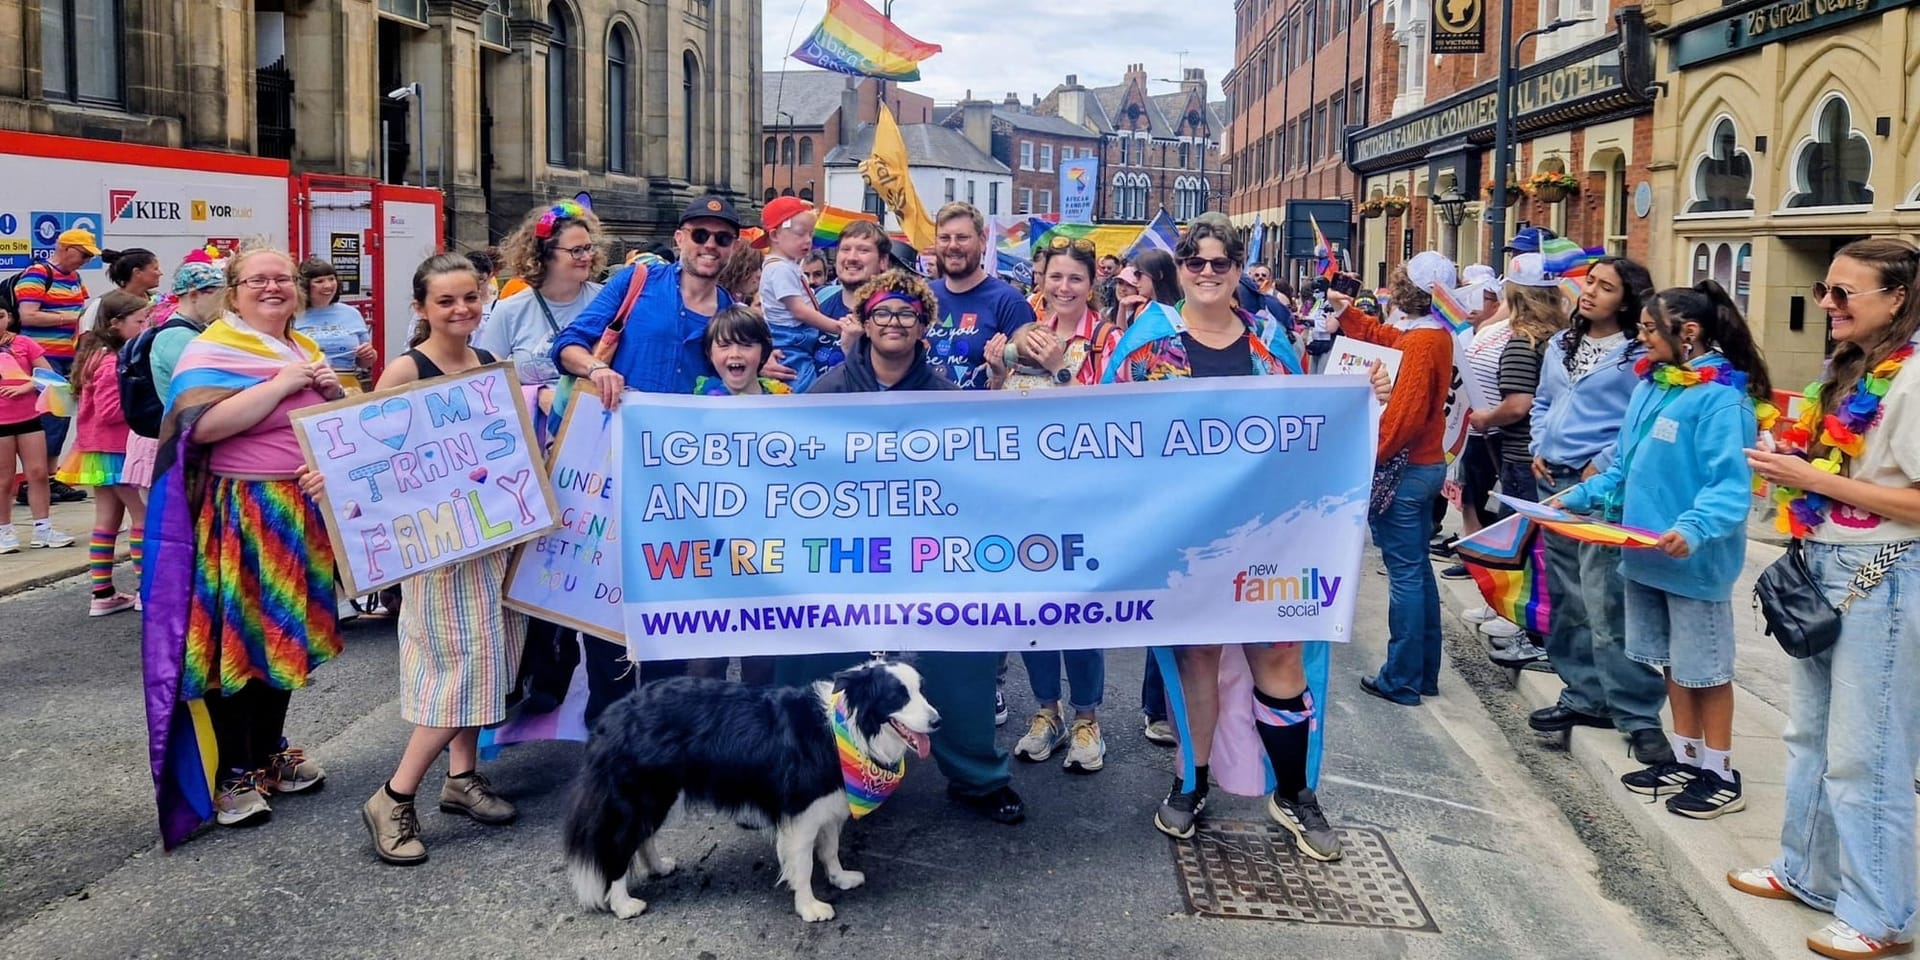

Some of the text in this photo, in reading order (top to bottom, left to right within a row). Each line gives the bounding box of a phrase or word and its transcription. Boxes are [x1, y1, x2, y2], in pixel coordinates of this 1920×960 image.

[1747, 9, 1766, 36] 26
[1769, 0, 1812, 29] Great
[1356, 131, 1393, 160] VICTORIA
[1396, 117, 1430, 150] FAMILY
[1430, 113, 1439, 139] &
[1441, 80, 1534, 134] COMMERIAL
[135, 201, 181, 220] KIER
[13, 241, 28, 251] Site
[926, 322, 979, 345] be you
[947, 355, 968, 365] me
[316, 376, 500, 459] I MY
[348, 418, 517, 502] TRANS
[641, 415, 1326, 468] LGBTQ+ PEOPLE CAN ADOPT
[558, 467, 613, 500] UNDE
[642, 478, 959, 522] AND FOSTER.
[360, 469, 536, 582] FAMILY
[641, 534, 1100, 581] WE'RE THE PROOF.
[1248, 564, 1278, 576] new
[1233, 567, 1342, 608] family
[641, 599, 1155, 636] WWW.NEWFAMILYSOCIAL.ORG.UK
[1277, 601, 1320, 618] social
